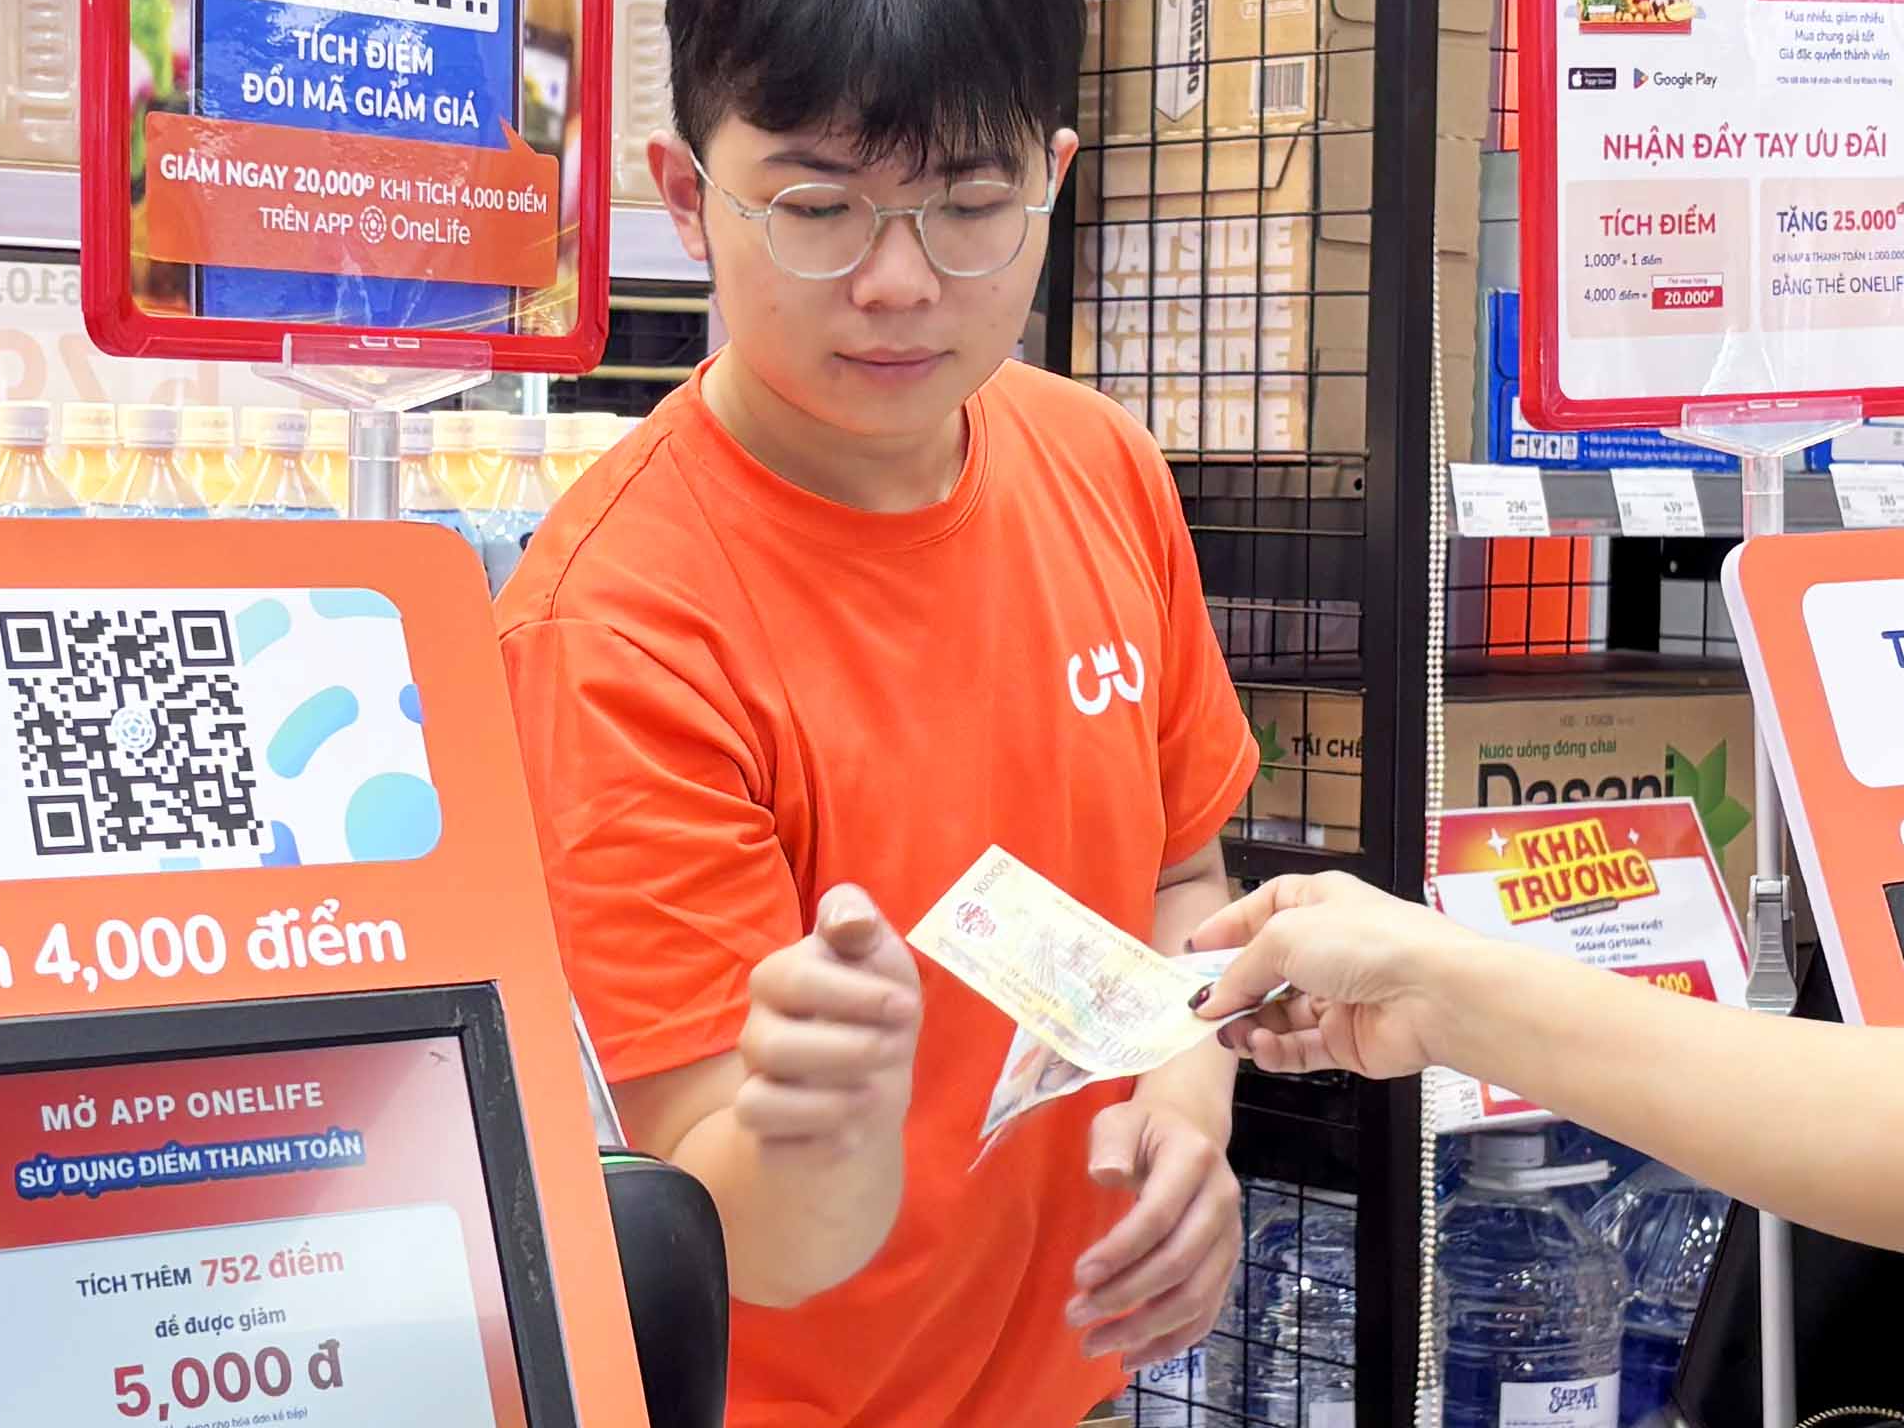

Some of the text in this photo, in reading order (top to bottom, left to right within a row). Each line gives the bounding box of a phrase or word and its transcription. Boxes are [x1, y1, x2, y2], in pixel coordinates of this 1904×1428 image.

[294, 28, 433, 77] TÍCH ĐIỂM
[242, 66, 479, 128] ĐỔI MÃ GIẢM GIÁ
[1603, 123, 1887, 165] NHẬN ĐẦY TAY ƯU ĐÃI
[160, 145, 220, 184] GIẢM
[226, 162, 289, 190] NGAY
[380, 179, 411, 203] KHI
[415, 177, 456, 205] TÍCH
[461, 188, 504, 210] 4,000
[507, 186, 548, 214] ĐIỂM
[1600, 204, 1716, 237] TÍCH ĐIỂM
[1776, 205, 1827, 238] TẶNG
[1520, 825, 1609, 870] KHAI
[1500, 856, 1650, 914] TRƯƠNG
[34, 916, 227, 993] 4,000
[246, 898, 407, 971] điểm
[41, 1082, 324, 1131] MỞ APP ONELIFE
[19, 1158, 55, 1189] SỬ
[63, 1161, 134, 1190] DỤNG
[205, 1140, 291, 1169] THANH
[295, 1131, 362, 1160] TOÁN
[76, 1274, 127, 1298] TÍCH
[134, 1265, 192, 1291] THÊM
[201, 1254, 261, 1287] 752
[113, 1339, 344, 1421] 5,000 đ
